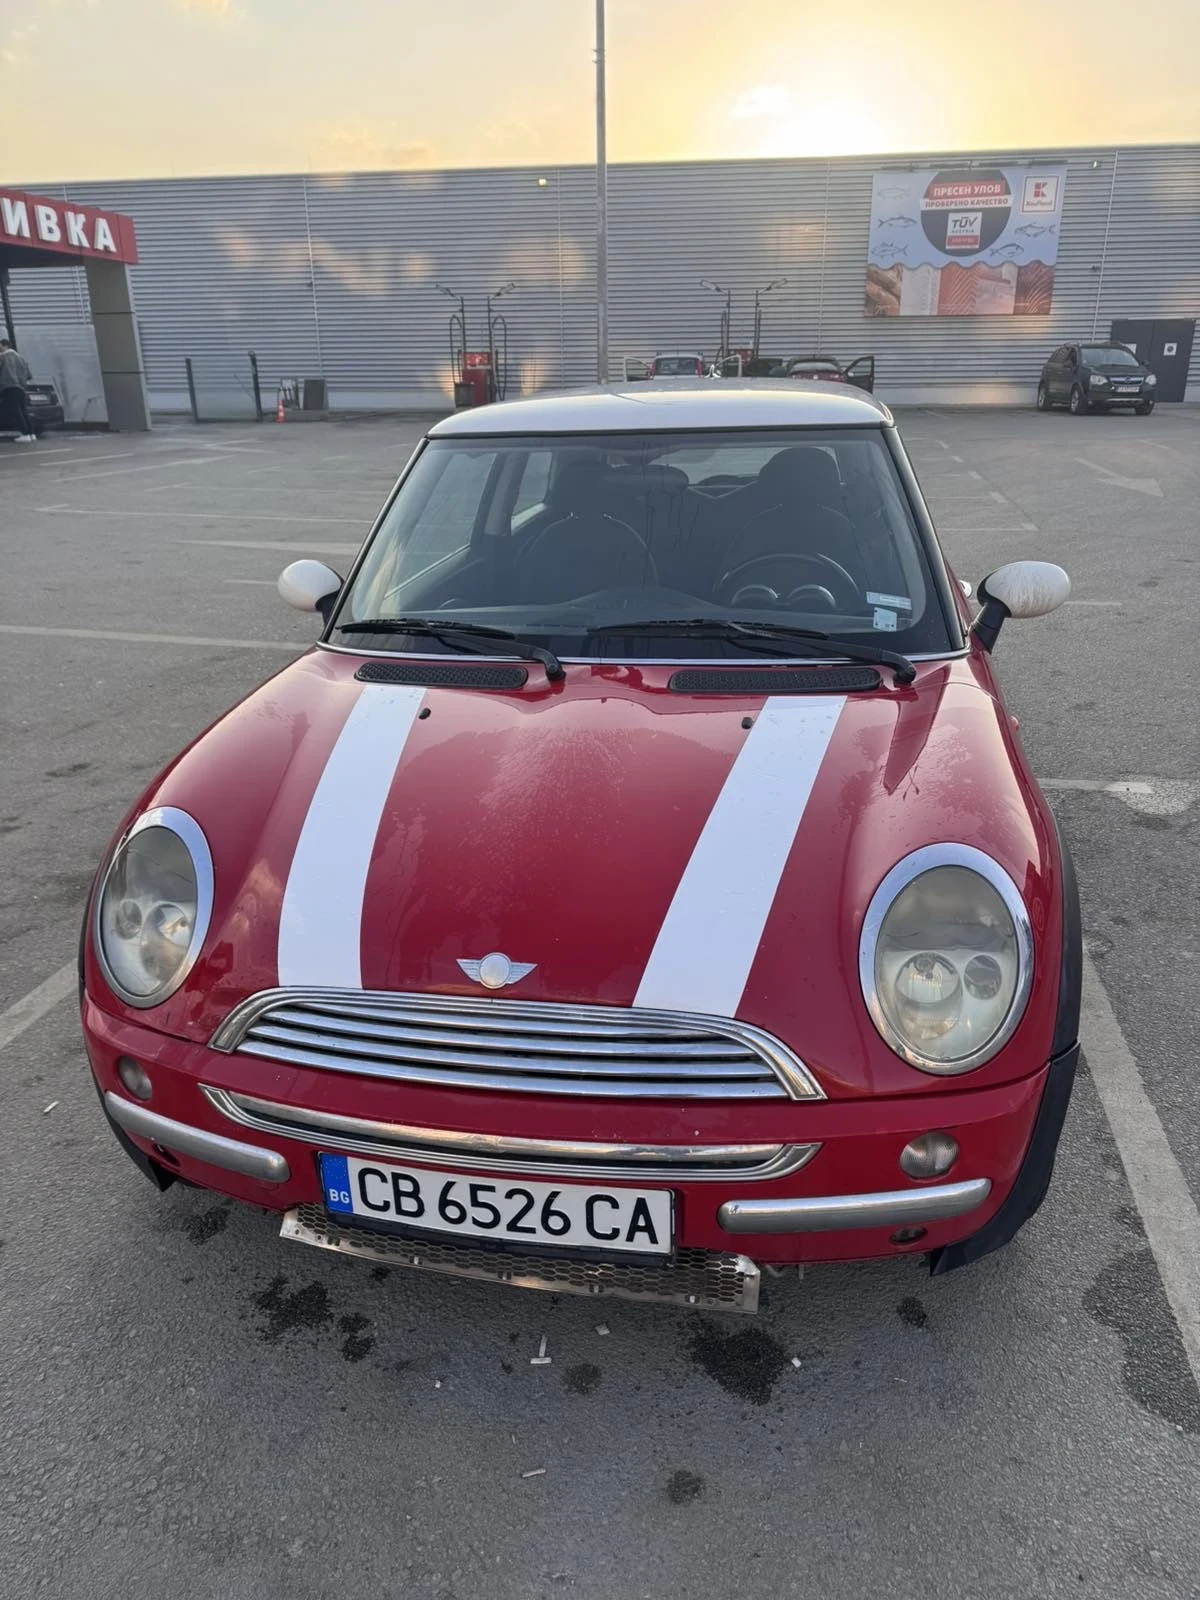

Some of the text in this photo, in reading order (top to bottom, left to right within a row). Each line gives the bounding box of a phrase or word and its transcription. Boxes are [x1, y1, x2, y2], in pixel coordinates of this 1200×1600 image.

[933, 184, 1001, 196] ПРЕСЕН УЛОВ
[925, 198, 1008, 209] ПРОВЕРЕНО КАЧЕСТВО
[952, 216, 978, 228] TÜV
[329, 1188, 350, 1204] BG
[357, 1167, 659, 1245] CB 6526 CA
